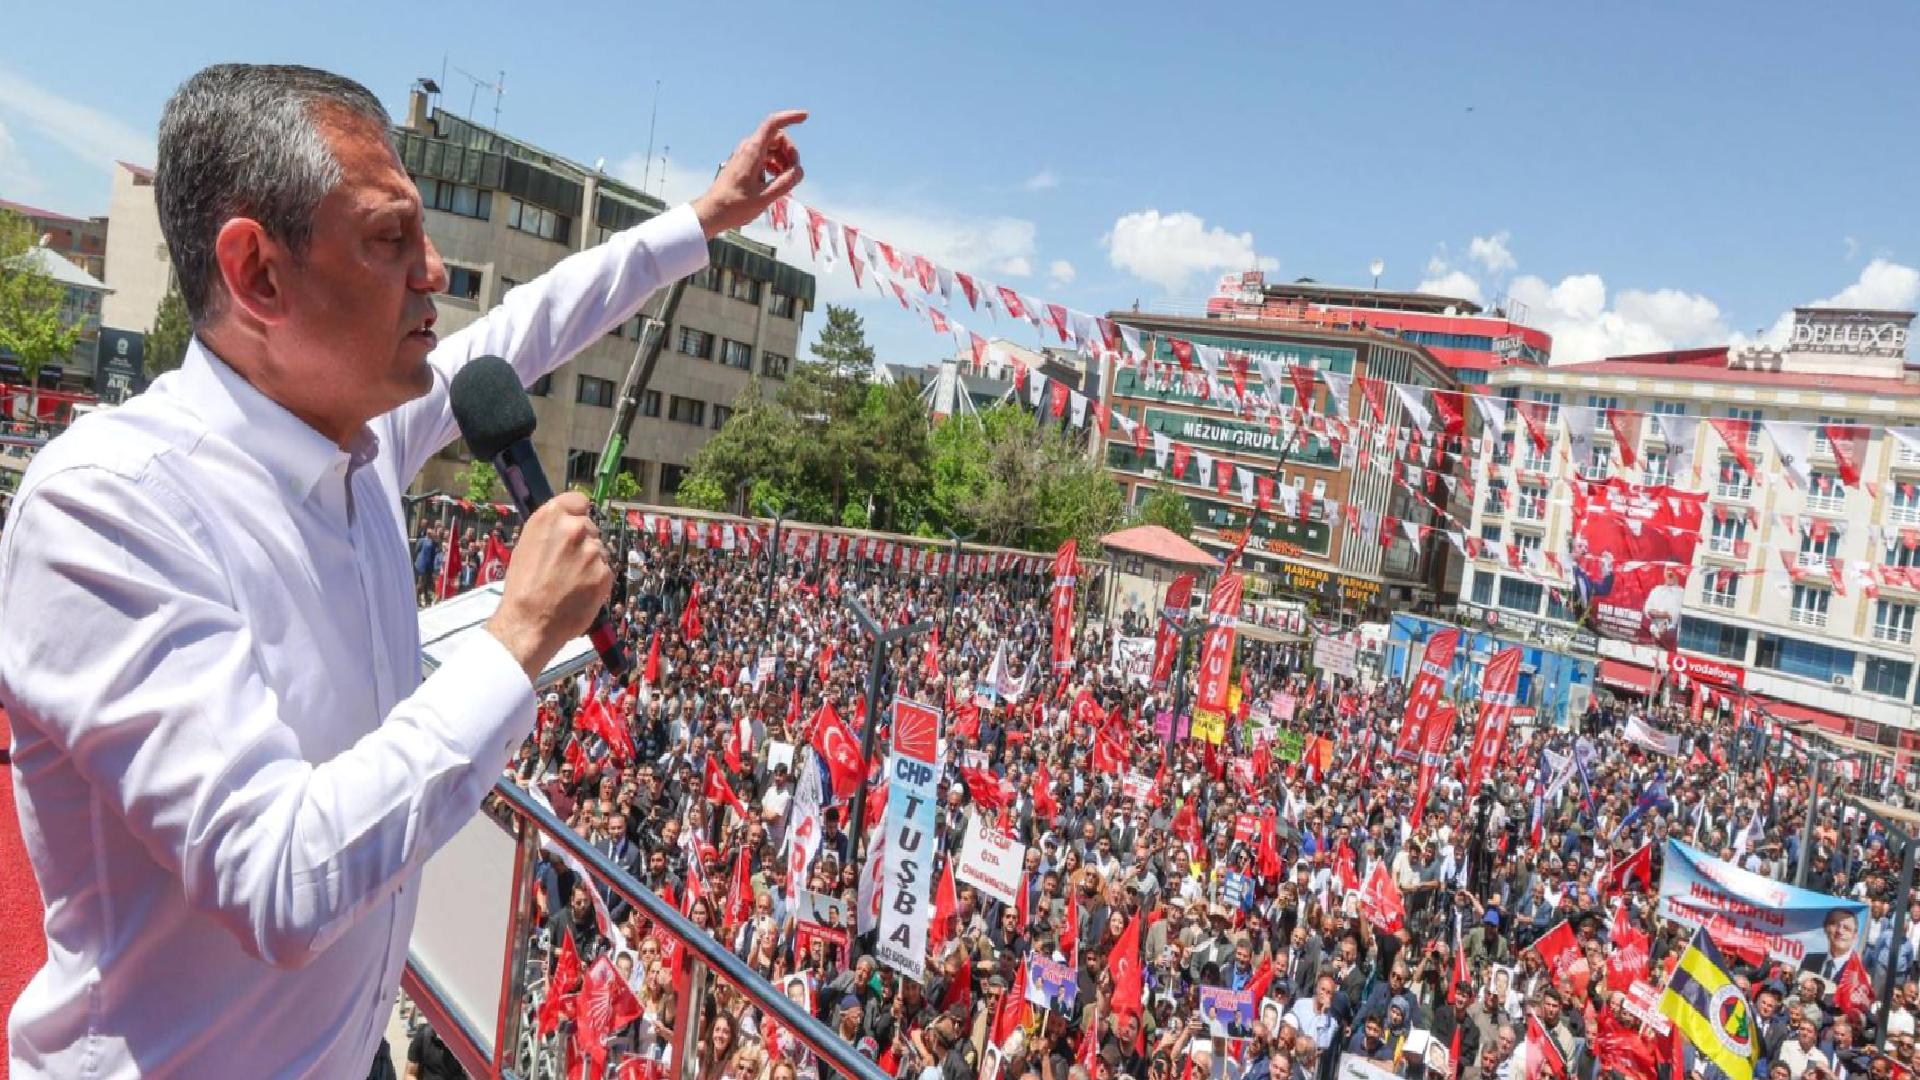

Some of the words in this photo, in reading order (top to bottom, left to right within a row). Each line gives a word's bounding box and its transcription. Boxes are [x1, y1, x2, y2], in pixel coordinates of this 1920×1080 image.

[1794, 322, 1907, 349] DELUXE
[1183, 422, 1232, 442] MEZUN
[1284, 562, 1330, 583] MARMARA
[1336, 574, 1382, 593] MARMARA
[1689, 661, 1738, 680] vodafone
[896, 758, 933, 787] CHP
[889, 795, 924, 949] TUŞBA
[1690, 881, 1726, 911] HALK
